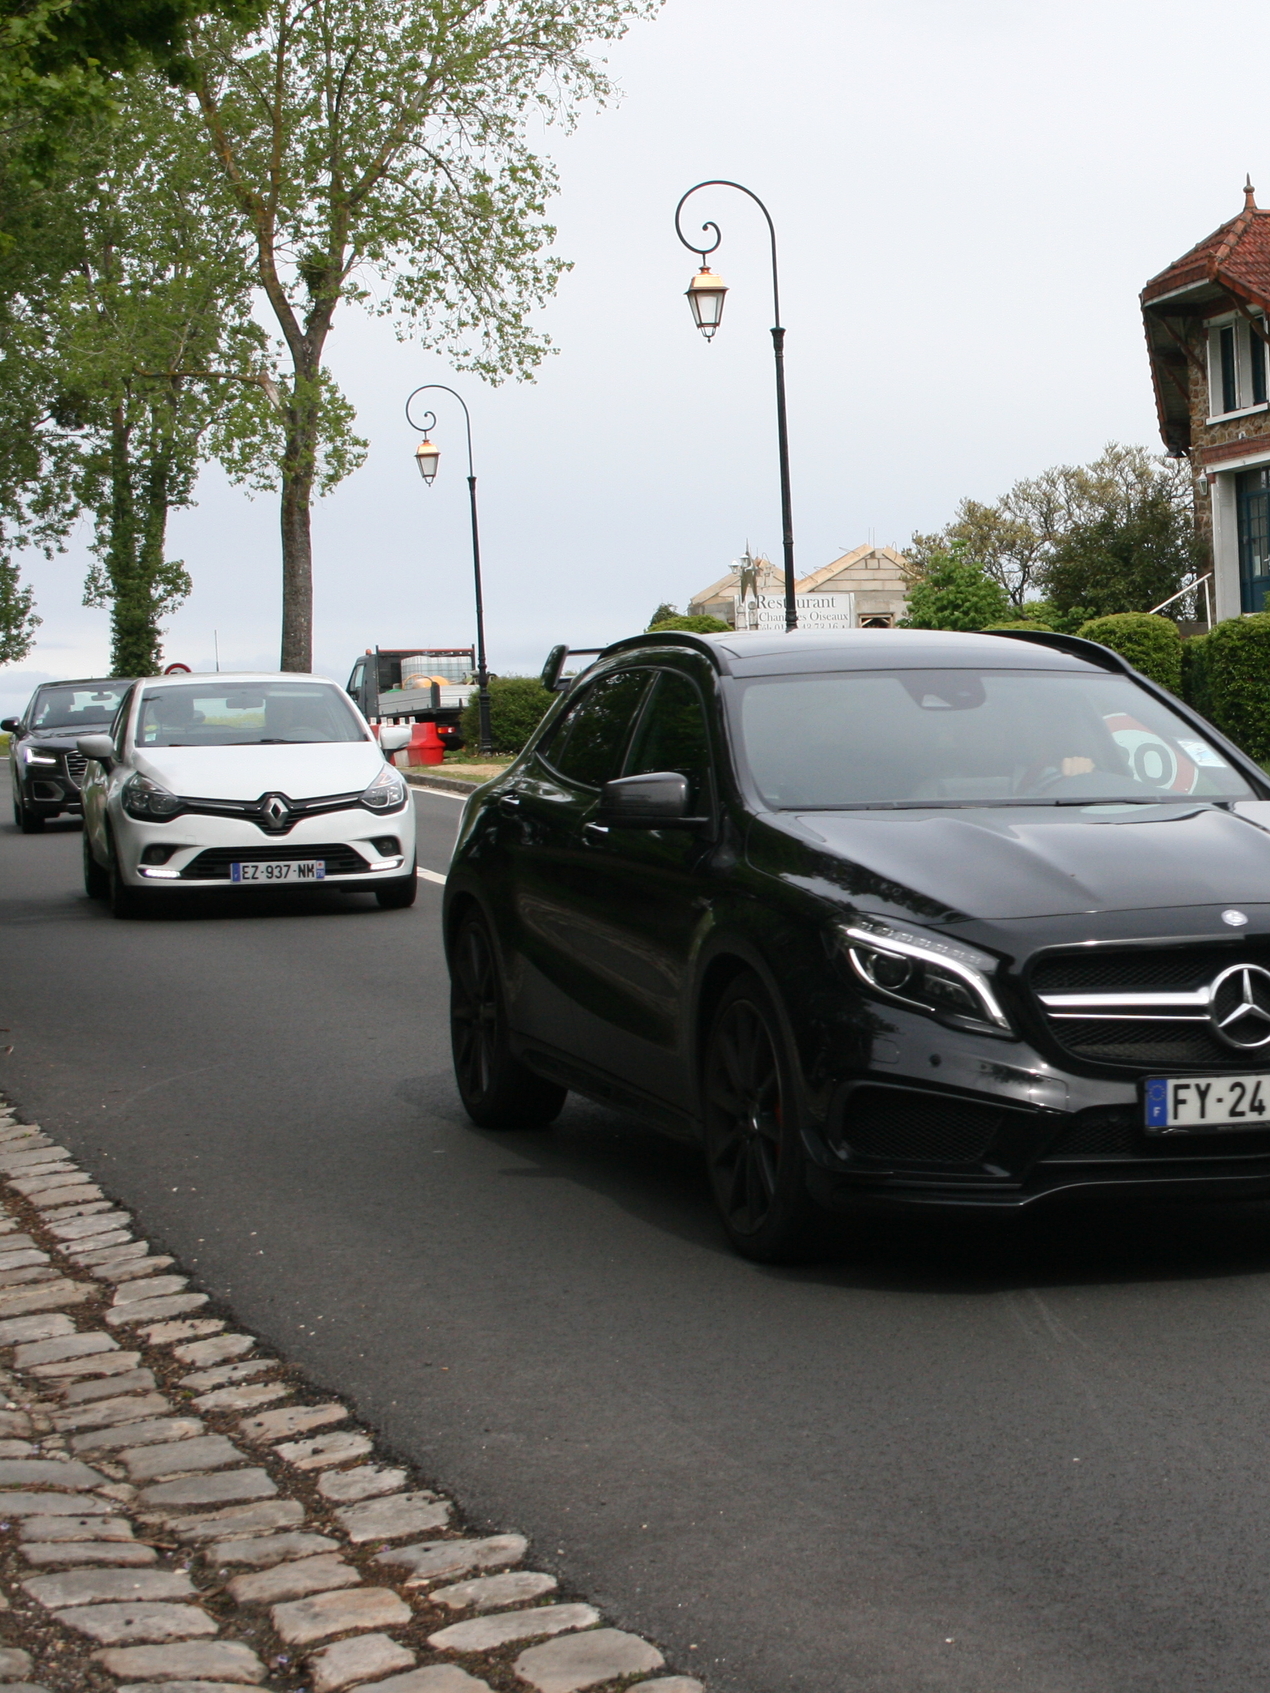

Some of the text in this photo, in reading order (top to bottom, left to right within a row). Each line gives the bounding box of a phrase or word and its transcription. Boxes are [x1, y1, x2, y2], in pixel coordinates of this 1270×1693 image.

[759, 612, 786, 621] Chan
[810, 611, 849, 621] Oiseaux
[1153, 1106, 1161, 1117] F
